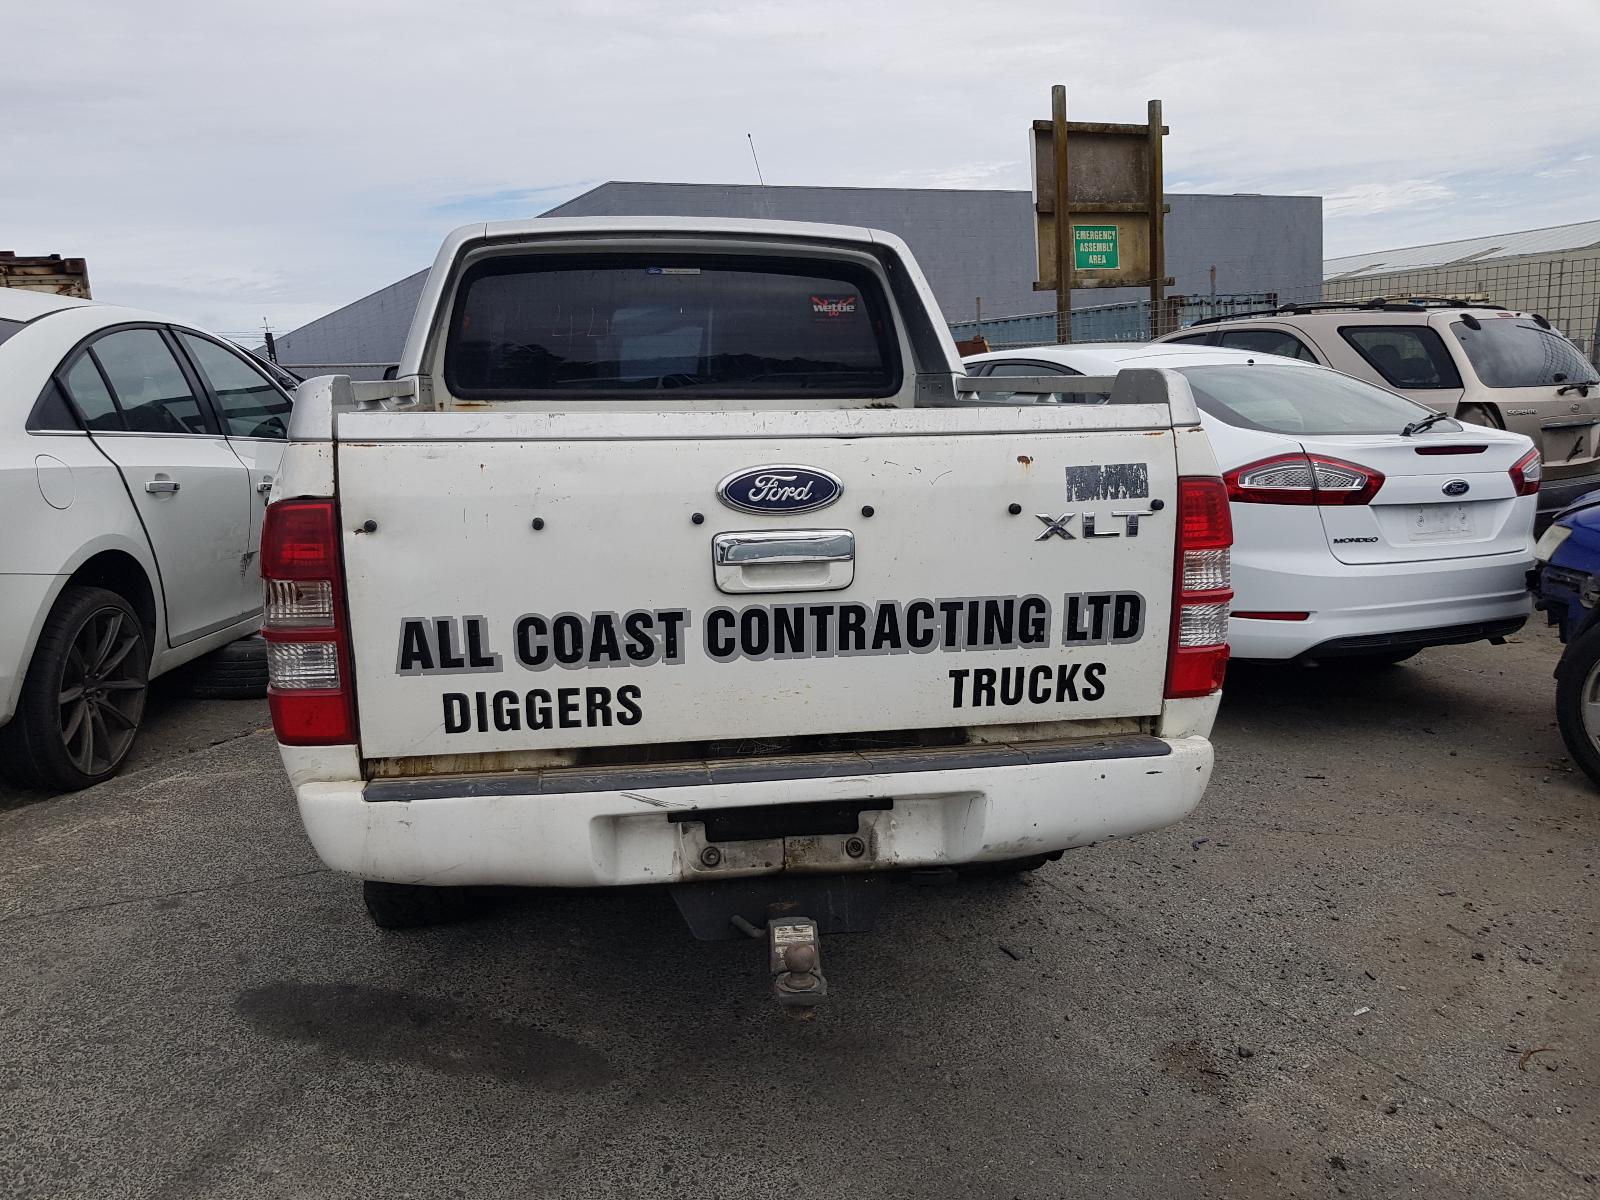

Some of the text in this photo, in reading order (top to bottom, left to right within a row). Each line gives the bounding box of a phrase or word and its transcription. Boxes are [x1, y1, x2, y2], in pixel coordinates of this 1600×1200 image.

[1076, 230, 1116, 240] EMERGENCY
[1080, 242, 1113, 252] ASSEMBLY
[1088, 254, 1107, 264] AREA
[747, 474, 813, 502] Ford
[1035, 510, 1154, 541] XLT
[1333, 536, 1379, 544] MONDEO
[398, 592, 1145, 674] ALL COAST CONTRACTING LTD
[948, 662, 1107, 708] TRUCKS
[442, 684, 643, 734] DIGGERS
